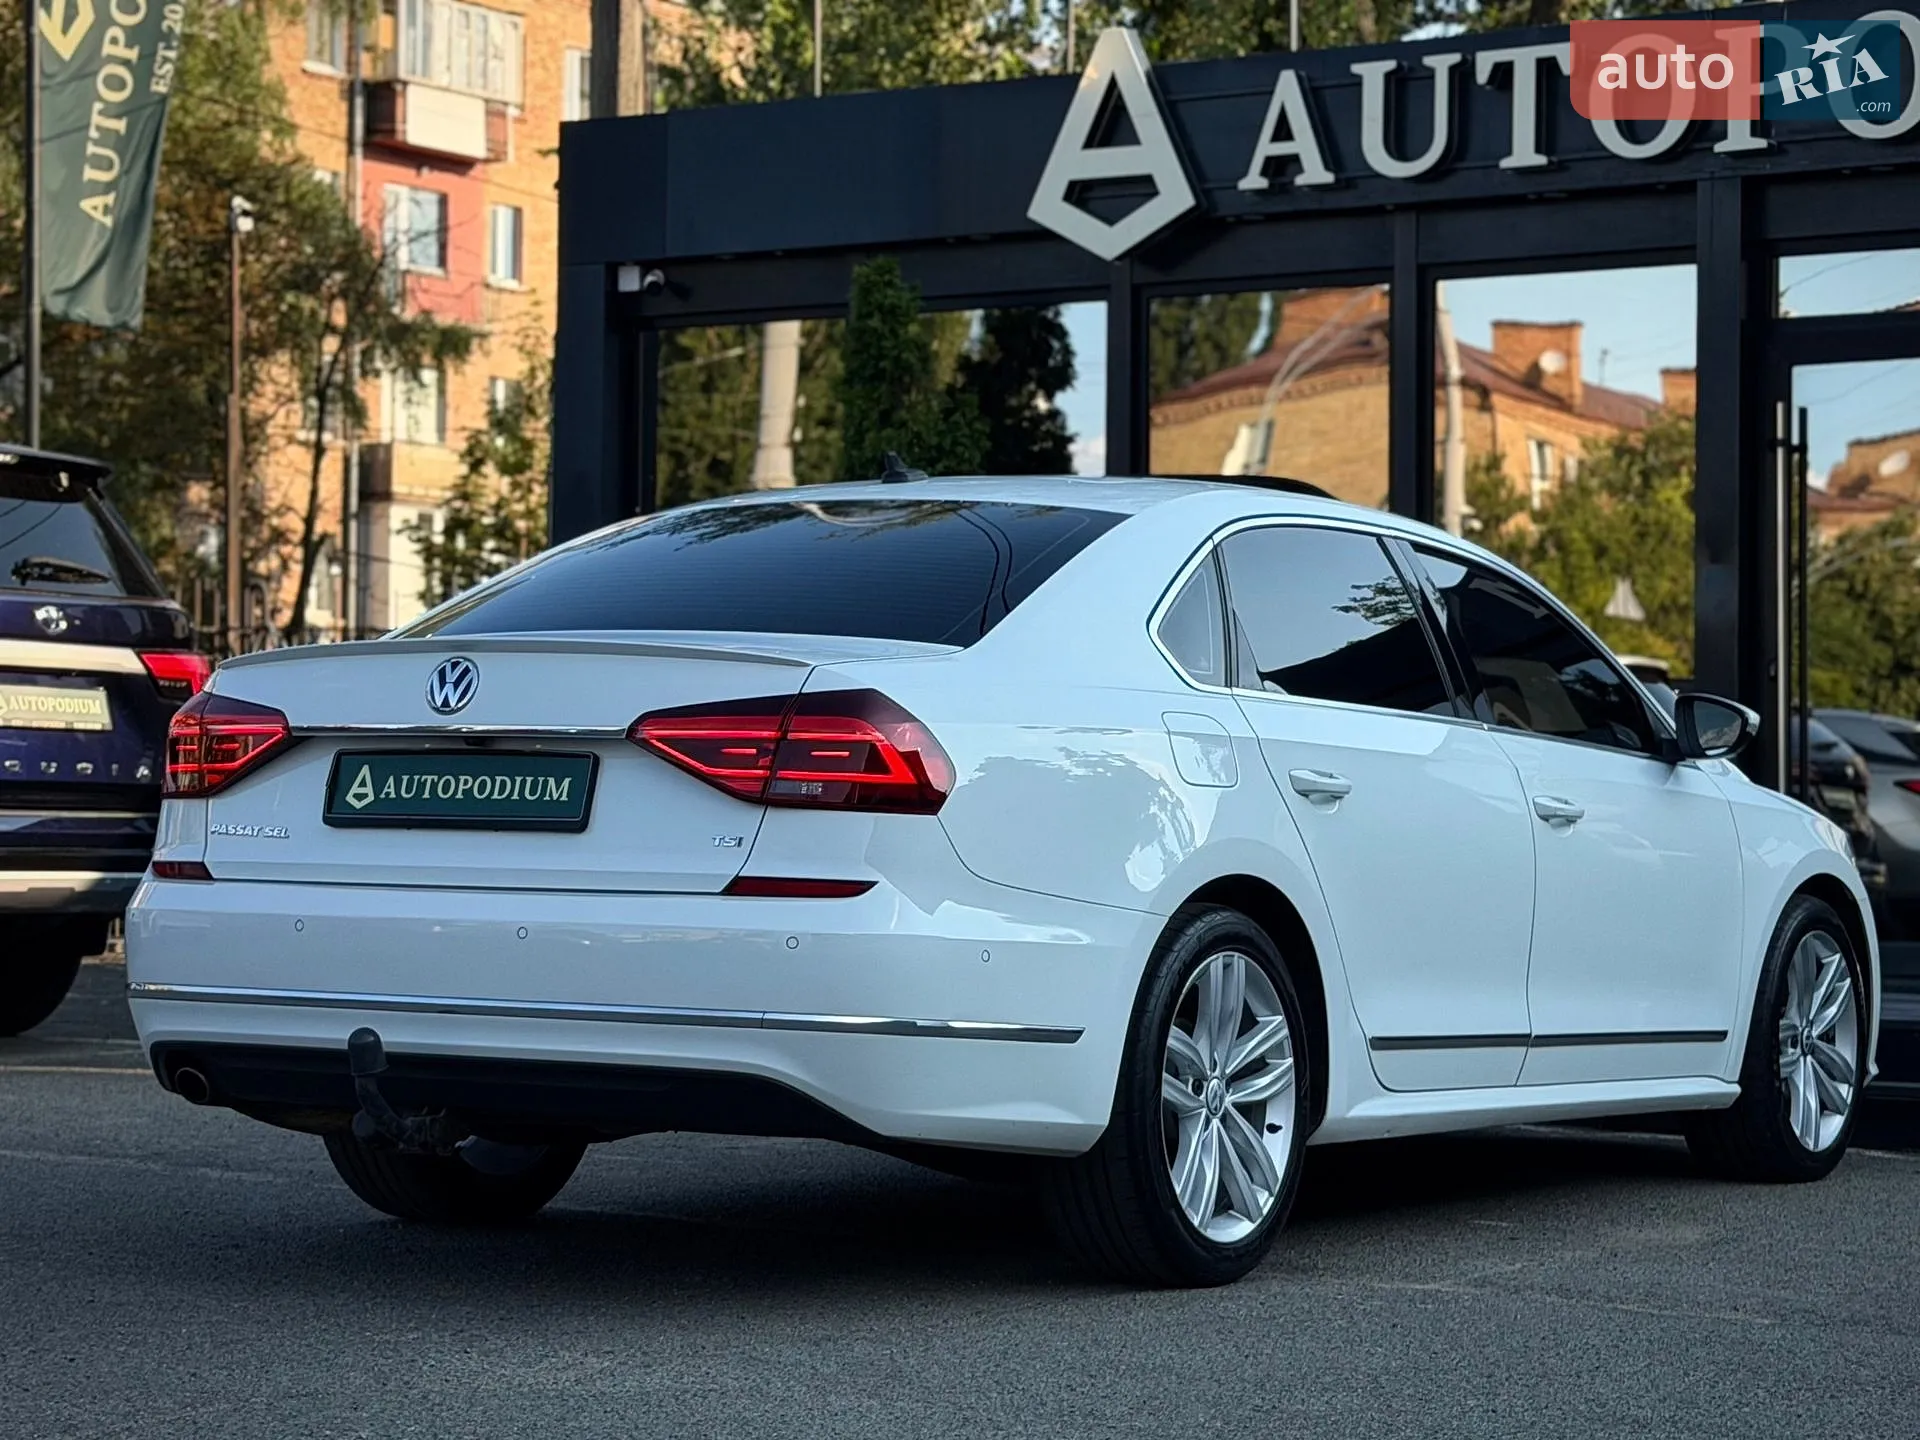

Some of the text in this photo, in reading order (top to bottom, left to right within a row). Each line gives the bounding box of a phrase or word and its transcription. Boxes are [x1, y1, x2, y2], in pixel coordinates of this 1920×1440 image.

[150, 0, 186, 94] EST. 20
[9, 694, 102, 715] AUTOPODIUM
[379, 774, 572, 802] AUTOPODIUM
[210, 823, 290, 839] PASSAT SEL
[712, 835, 744, 848] TSI
